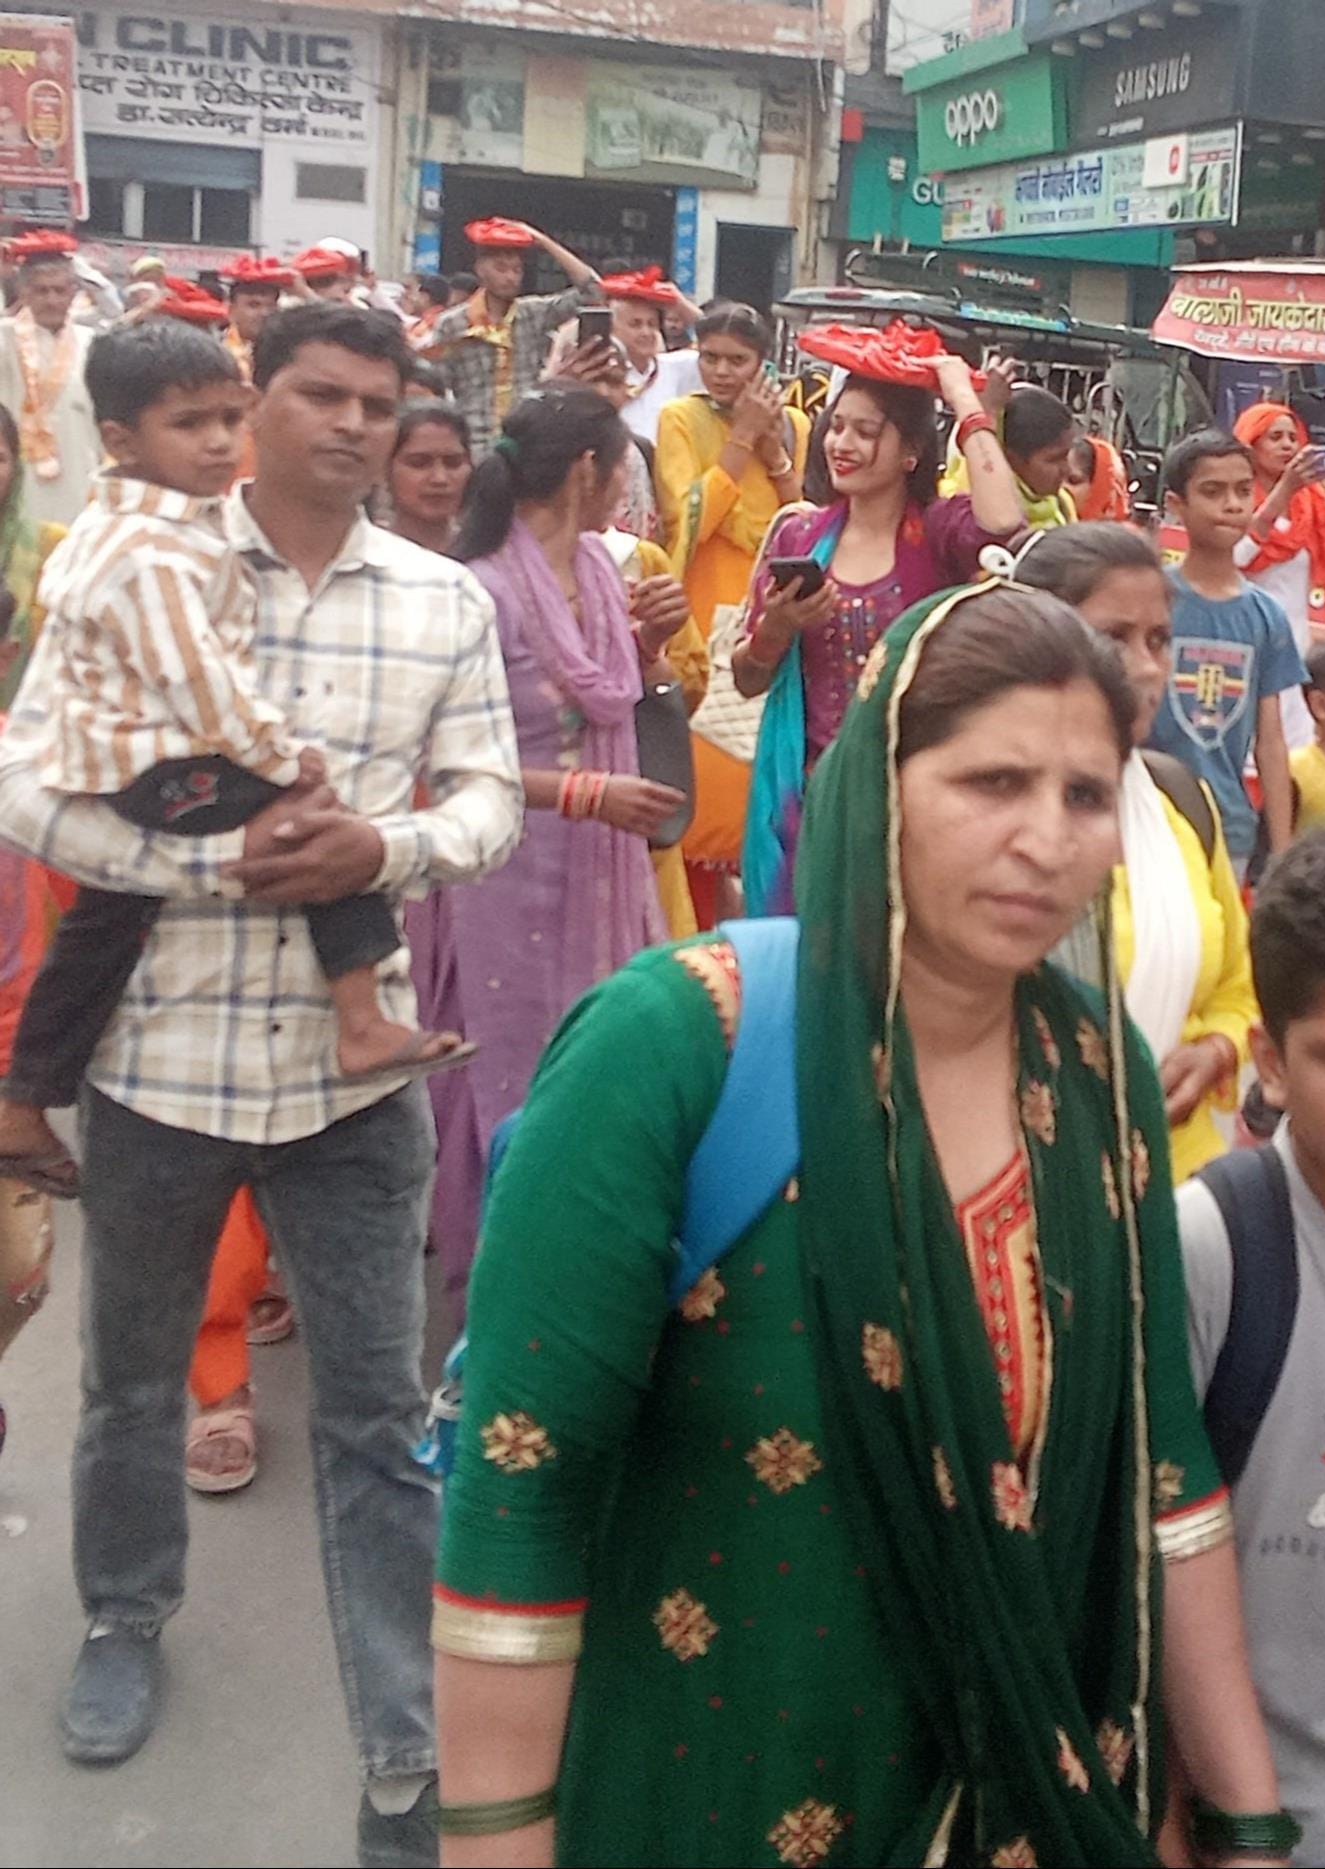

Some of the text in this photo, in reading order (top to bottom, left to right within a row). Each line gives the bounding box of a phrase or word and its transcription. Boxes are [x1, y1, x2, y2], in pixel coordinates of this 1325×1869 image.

[116, 16, 351, 70] CLINIC
[90, 53, 351, 94] TREATMENT CENTRE
[1115, 53, 1191, 107] SAMSUNG
[1171, 286, 1243, 326] बालाजी
